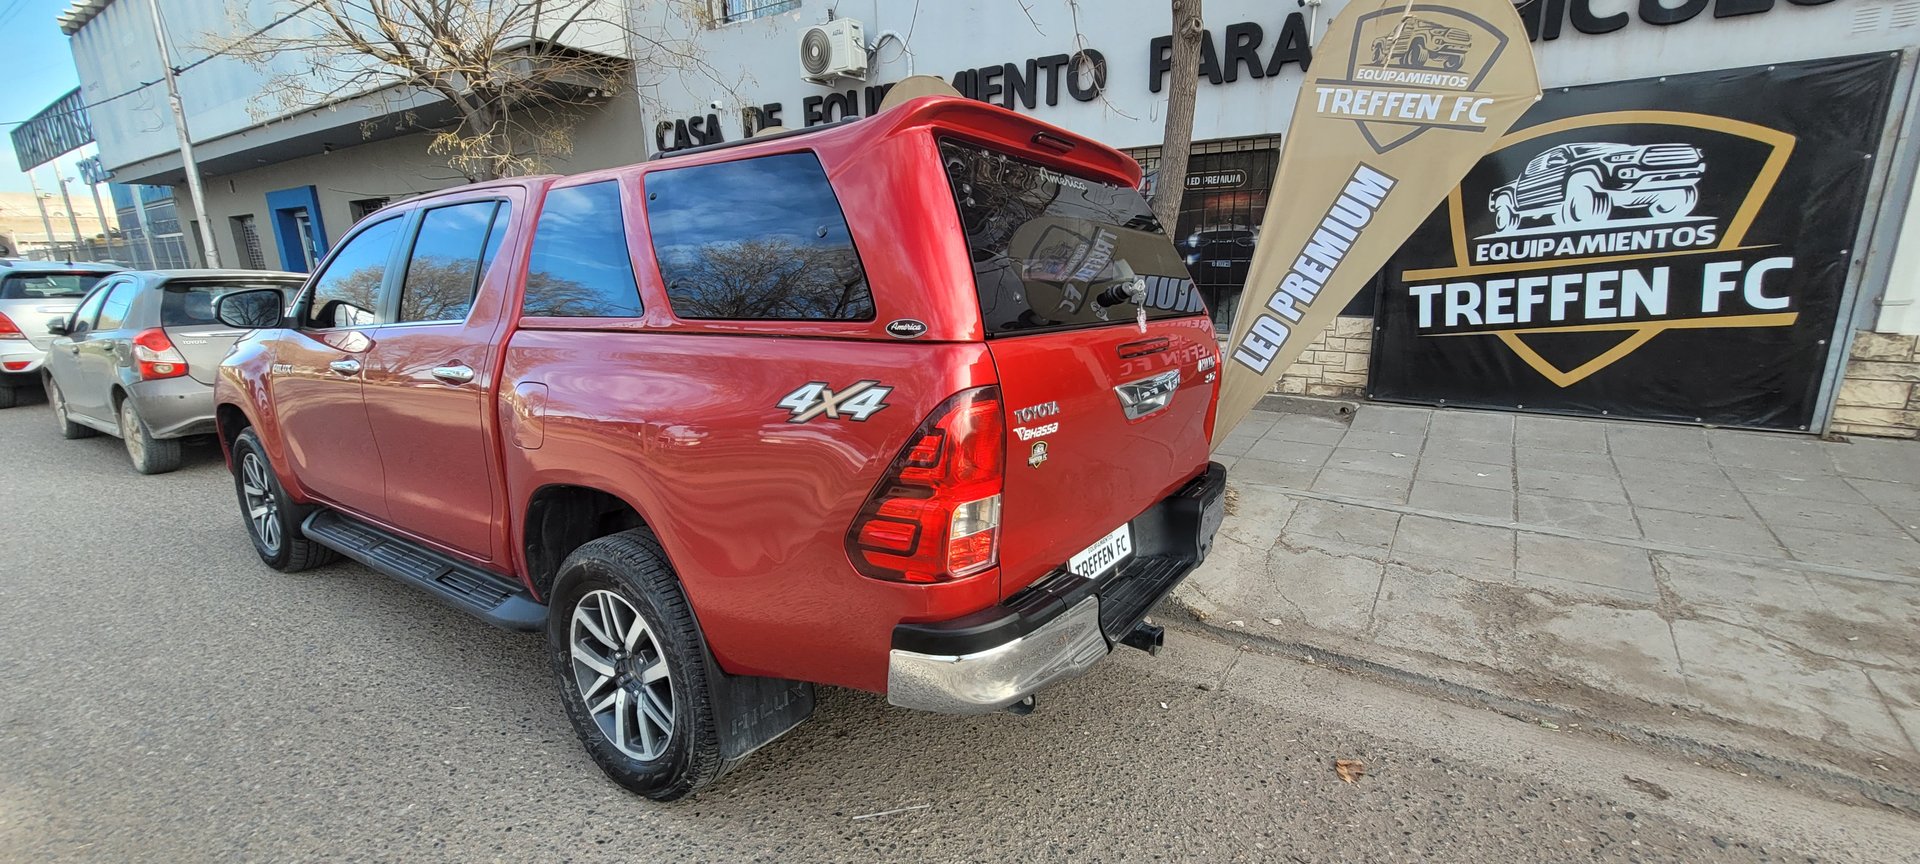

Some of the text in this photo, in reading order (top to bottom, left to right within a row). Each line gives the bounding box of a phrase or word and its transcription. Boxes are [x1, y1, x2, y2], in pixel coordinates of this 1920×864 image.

[1356, 69, 1469, 87] EQUIPAMIENTOS
[656, 113, 725, 151] CASA
[742, 102, 783, 138] DE
[803, 48, 1107, 128] EQUIIENTO
[1315, 87, 1494, 123] TREFFEN FC
[1187, 174, 1241, 186] LED PREMIUM
[1475, 225, 1717, 262] EQUIPAMIENTOS
[1233, 164, 1395, 374] LED PREMIUM
[1409, 257, 1794, 328] TREFFEN FC
[1014, 401, 1060, 424] TOYOTA
[1075, 534, 1127, 577] TREFFEN FC
